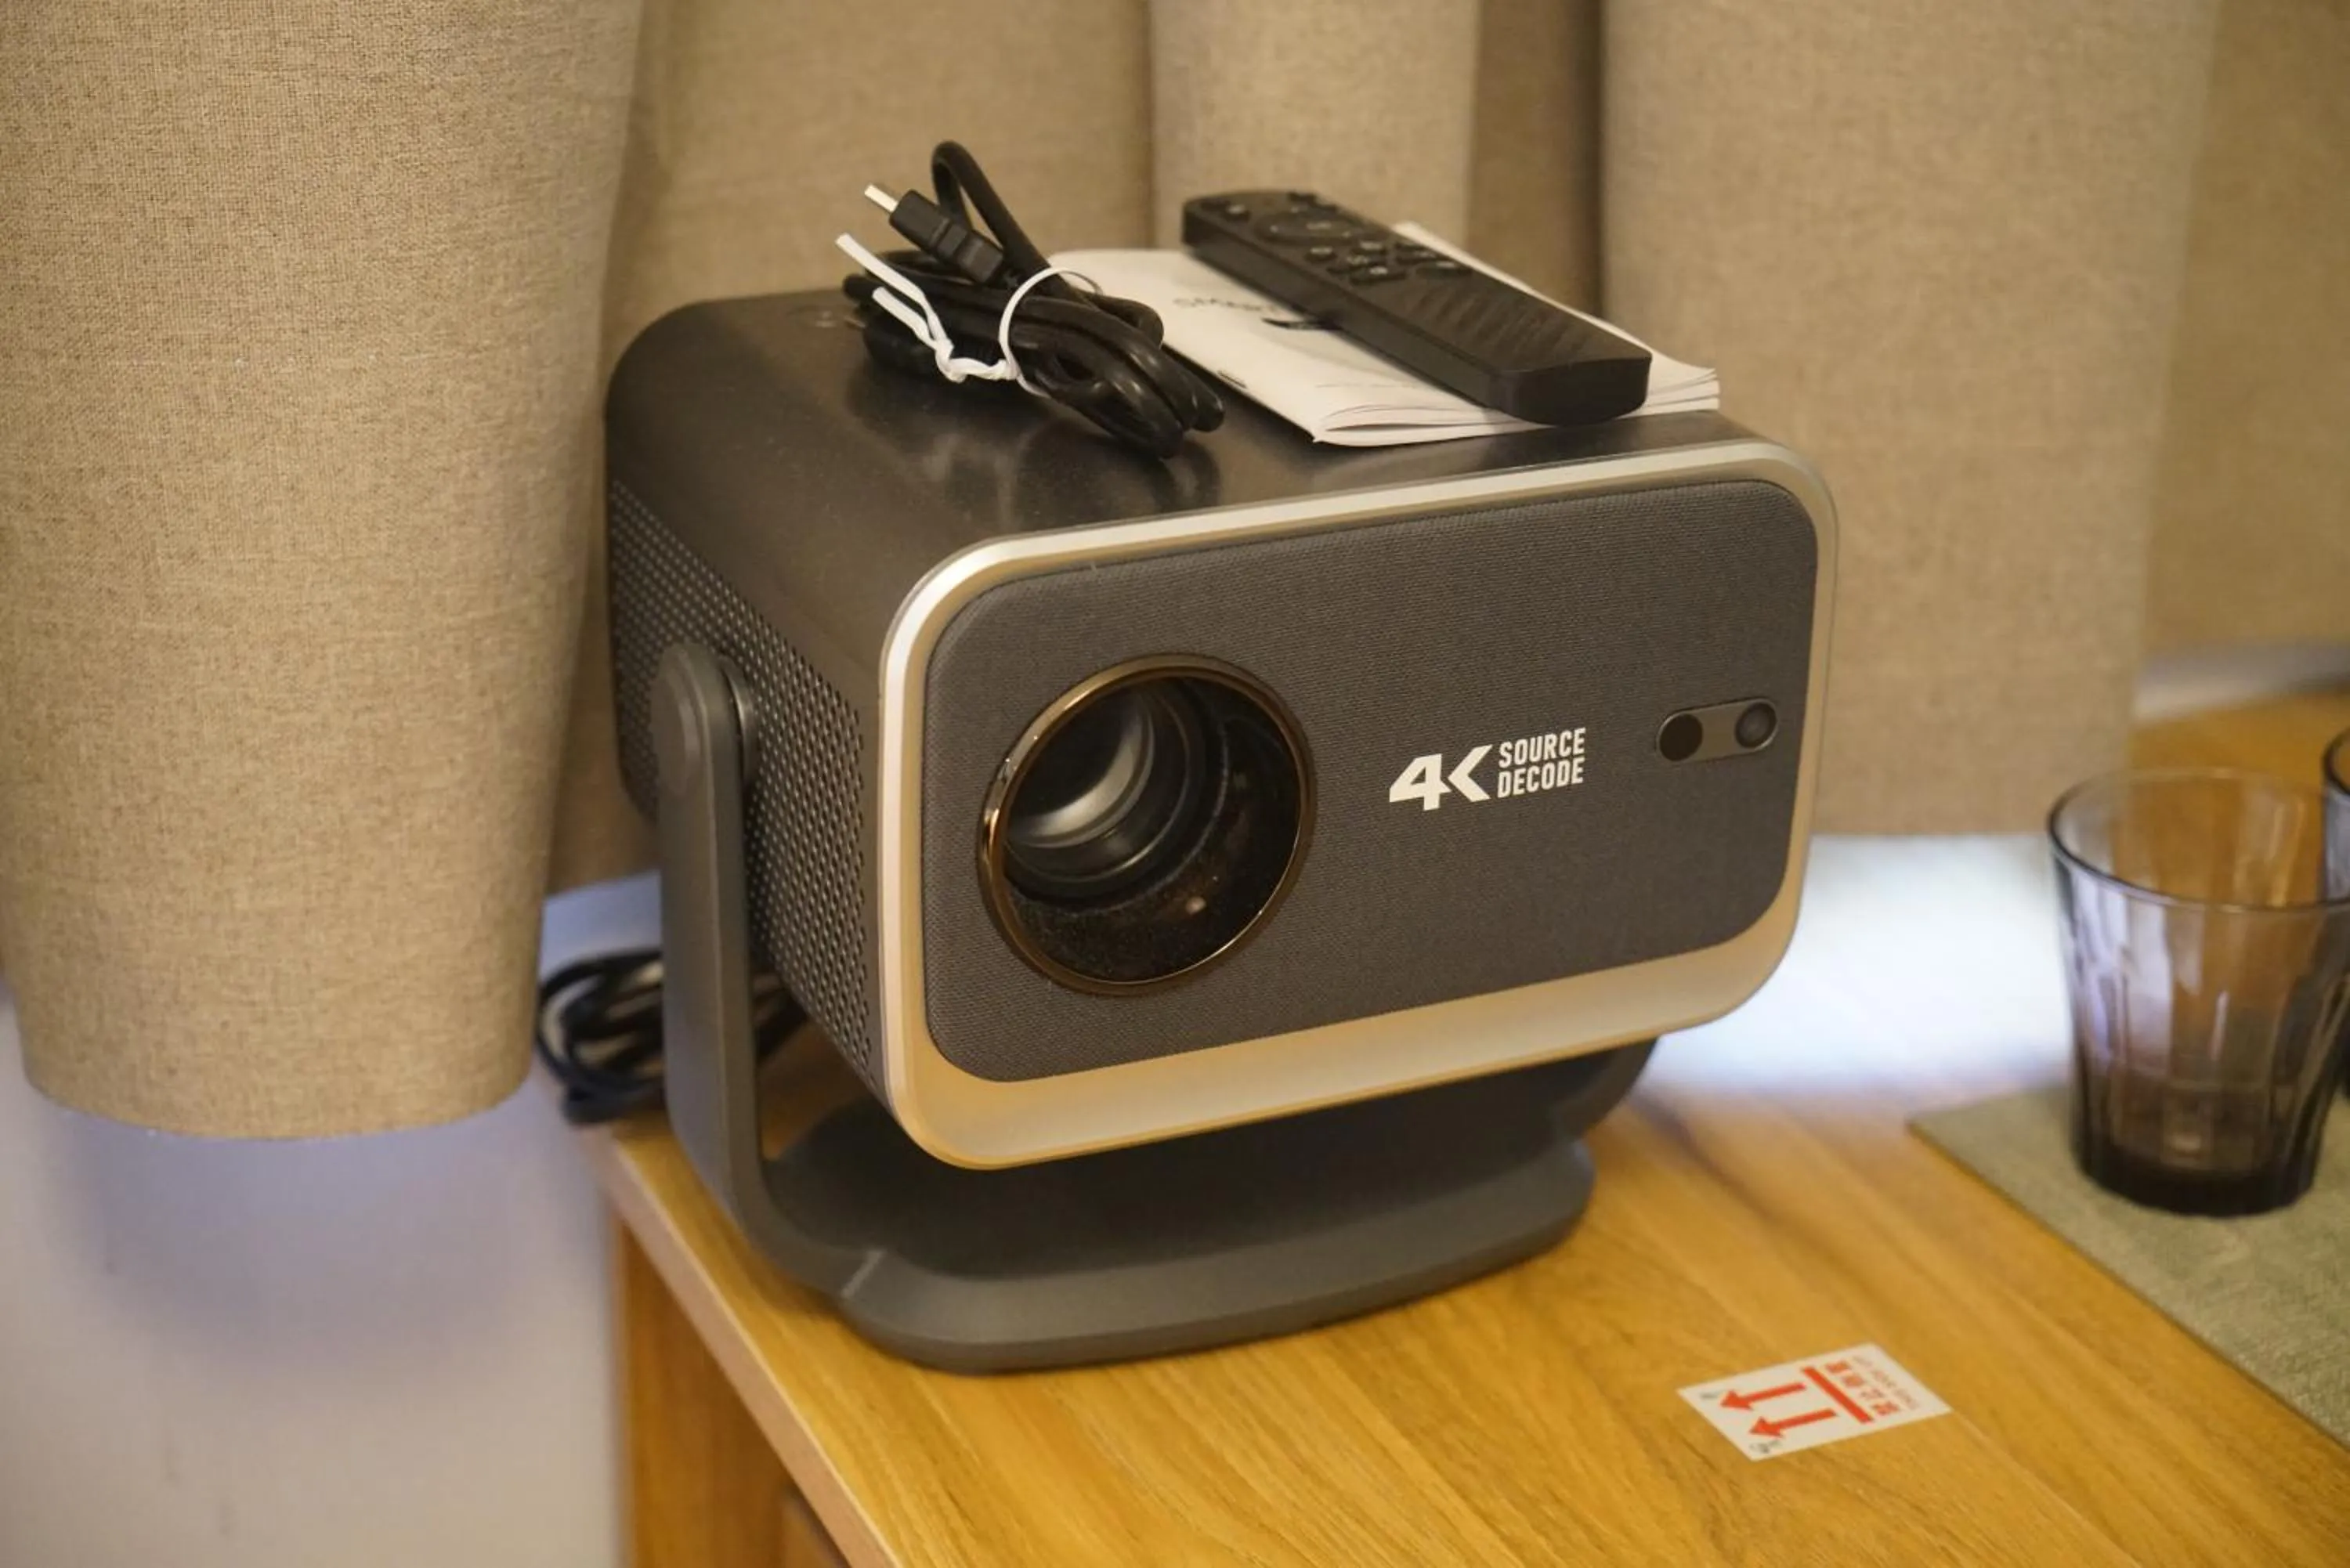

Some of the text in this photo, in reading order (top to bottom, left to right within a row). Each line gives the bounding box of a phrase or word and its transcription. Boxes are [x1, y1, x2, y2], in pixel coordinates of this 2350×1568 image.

[1498, 727, 1586, 768] SOURCE
[1389, 744, 1493, 811] 4K
[1497, 757, 1585, 798] DECODE
